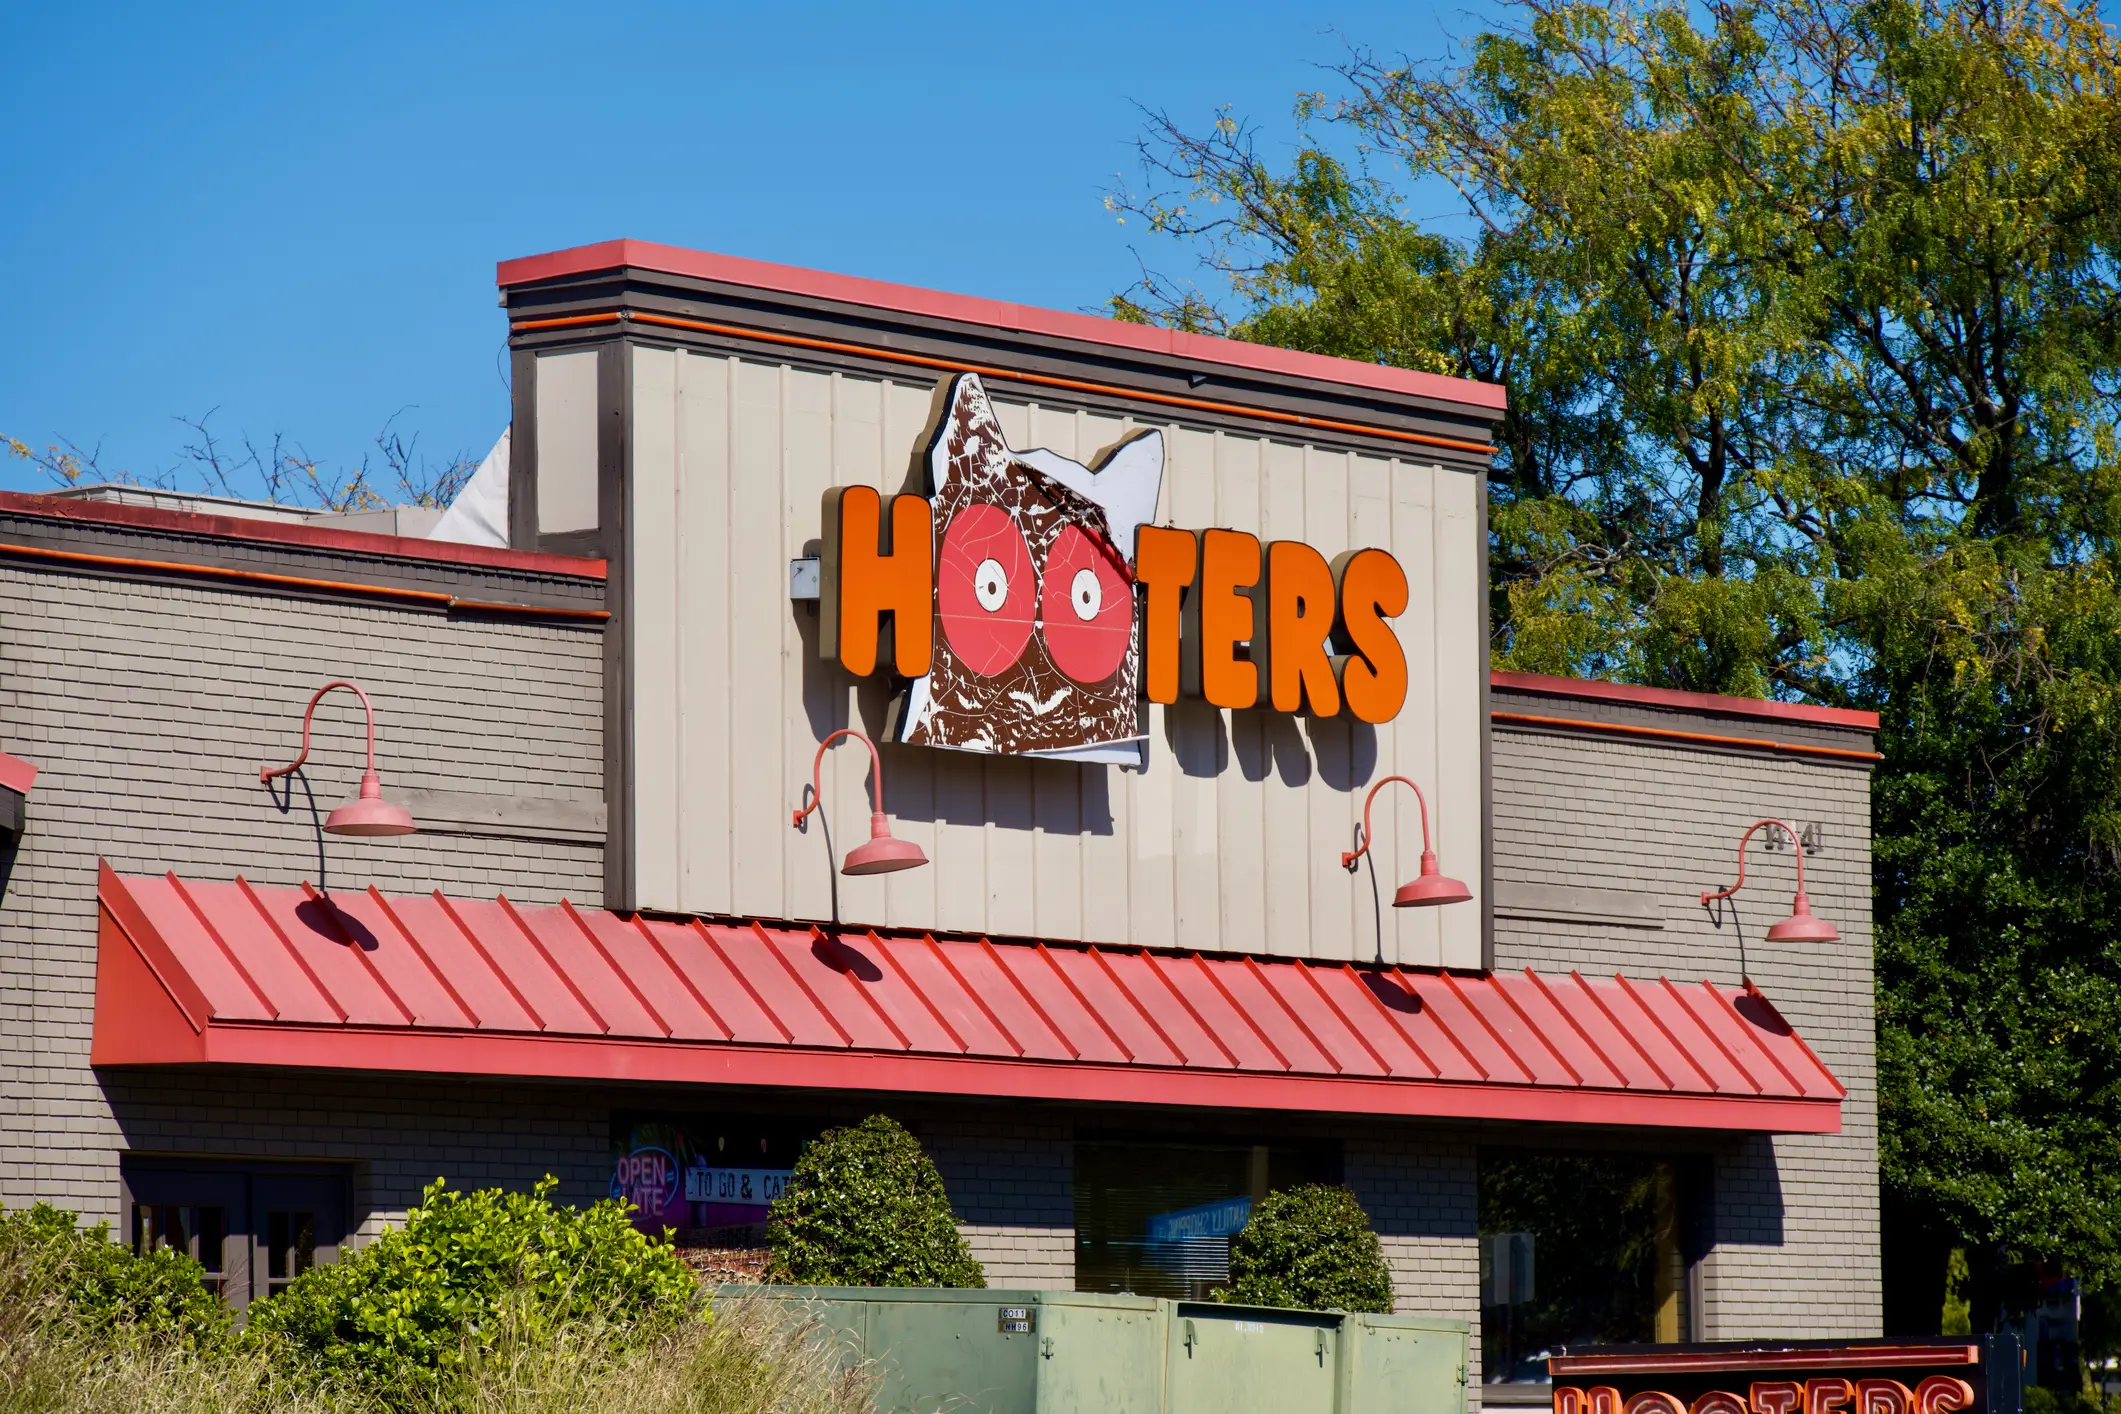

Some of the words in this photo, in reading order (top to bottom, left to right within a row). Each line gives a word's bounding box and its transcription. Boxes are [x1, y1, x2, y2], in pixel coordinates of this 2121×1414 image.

[838, 484, 1408, 724] HOOTERS
[617, 1155, 666, 1186] OPEN
[697, 1171, 712, 1197] TO
[719, 1171, 735, 1198] GO
[741, 1173, 752, 1199] &
[763, 1173, 798, 1200] CAT
